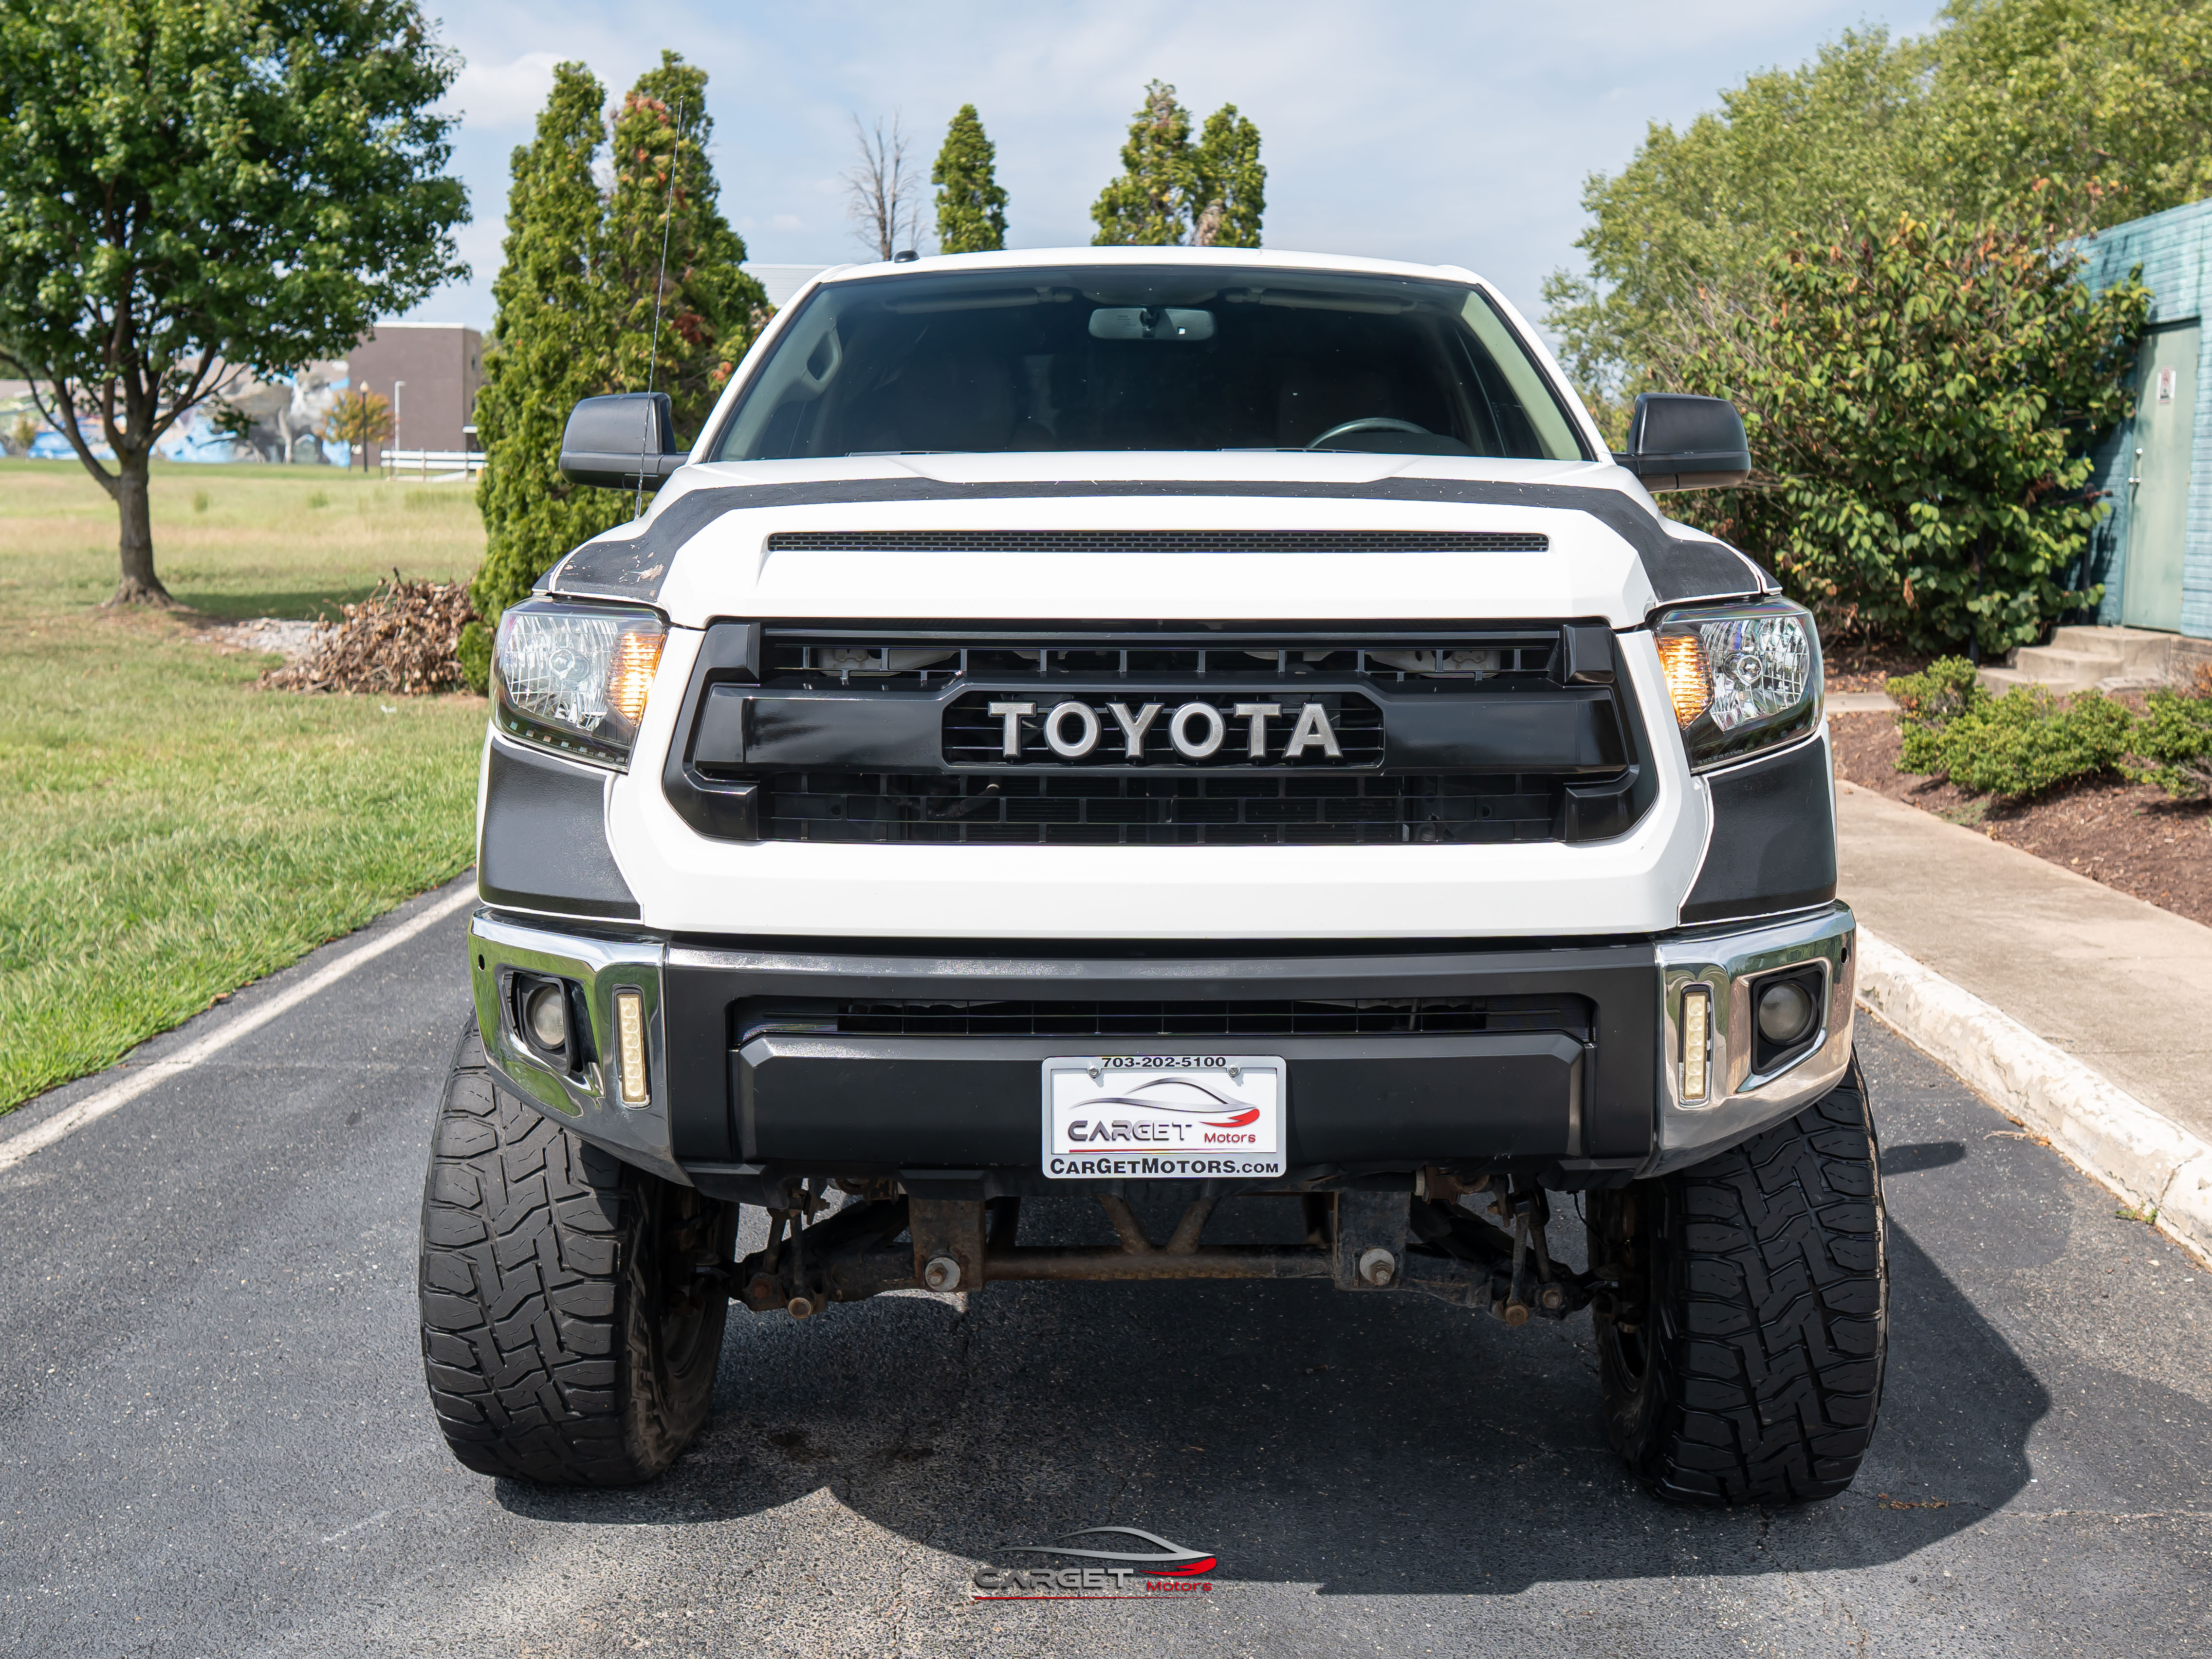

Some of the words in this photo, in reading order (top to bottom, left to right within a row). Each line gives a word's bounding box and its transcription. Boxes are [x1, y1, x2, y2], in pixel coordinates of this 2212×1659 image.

[989, 701, 1344, 760] TOYOTA
[1102, 1057, 1226, 1068] 703-202-5100
[1068, 1120, 1193, 1141] CARGET
[1204, 1132, 1256, 1143] Motors
